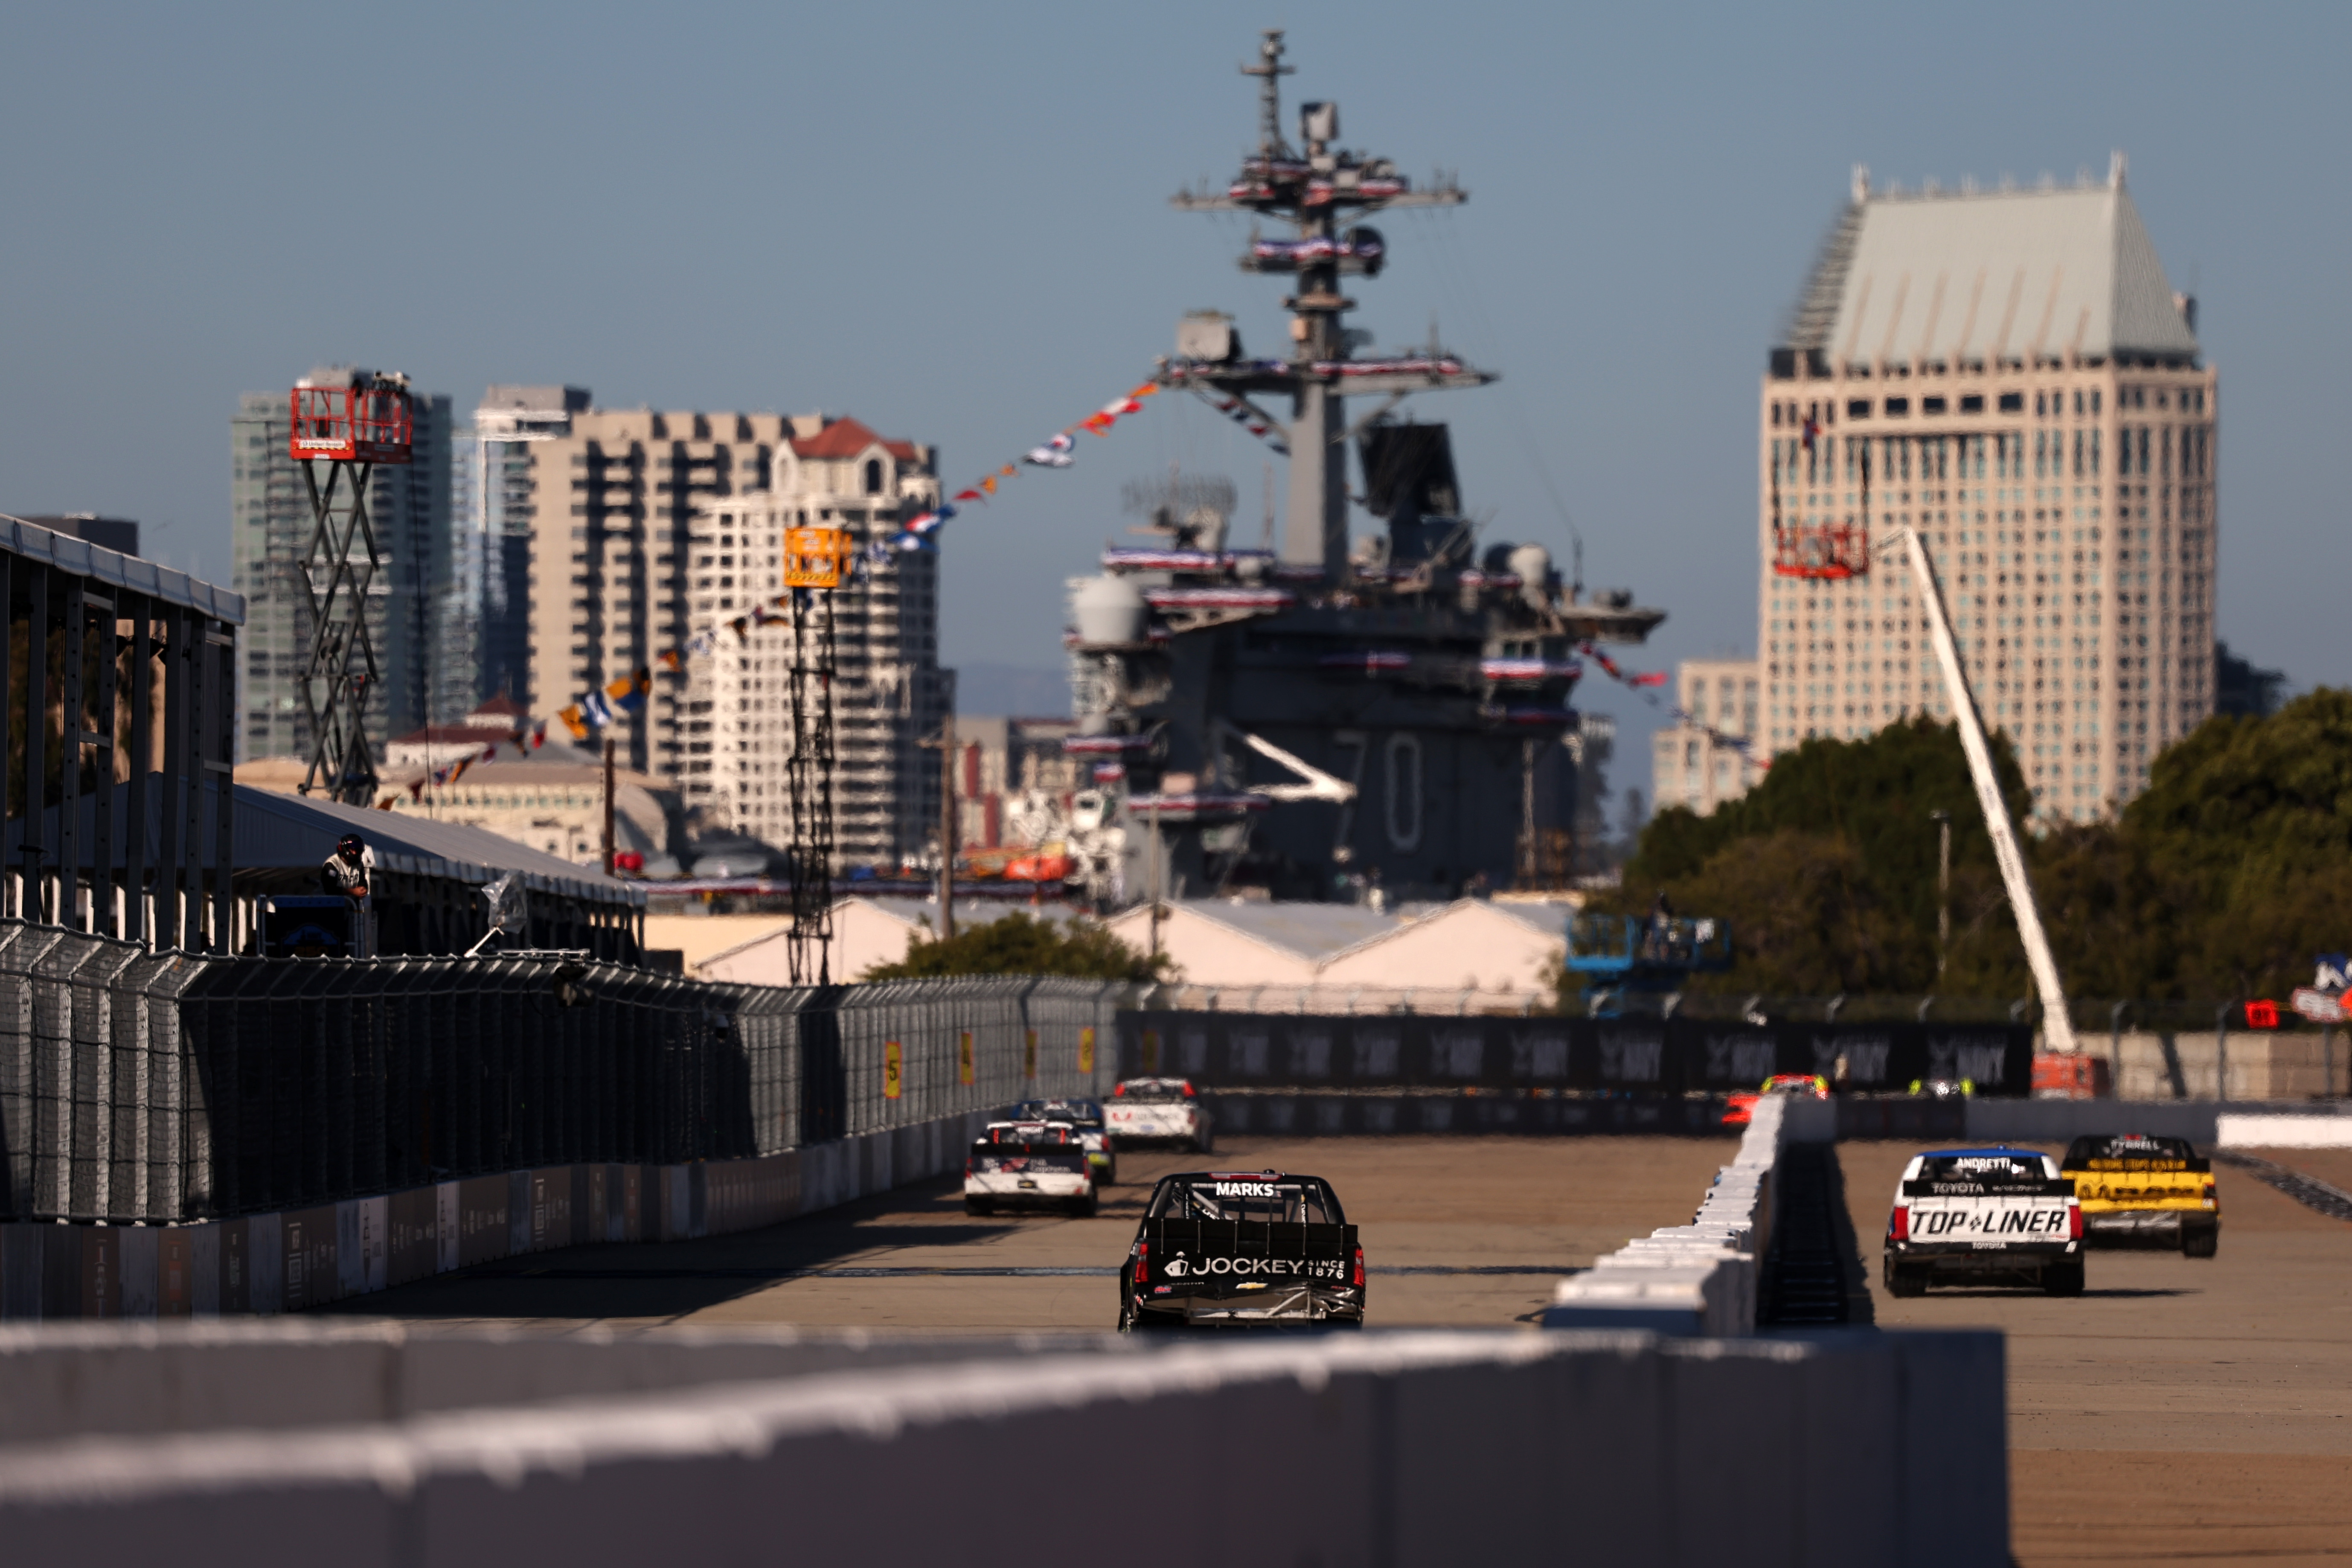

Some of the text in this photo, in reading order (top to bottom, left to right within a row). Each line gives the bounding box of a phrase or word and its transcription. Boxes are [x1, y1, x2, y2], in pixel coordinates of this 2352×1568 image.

[1334, 730, 1424, 852] 70
[890, 1059, 898, 1081] 5
[1956, 1157, 2011, 1170] ANDRETTI
[1216, 1182, 1274, 1197] MARKS
[1931, 1182, 1984, 1194] TOYOTA
[1912, 1210, 2066, 1235] TOP LINER
[1972, 1241, 2007, 1250] TOYOTA
[1192, 1257, 1305, 1275] JOCKEY
[1308, 1260, 1345, 1270] SINCE
[1307, 1267, 1344, 1280] 1876
